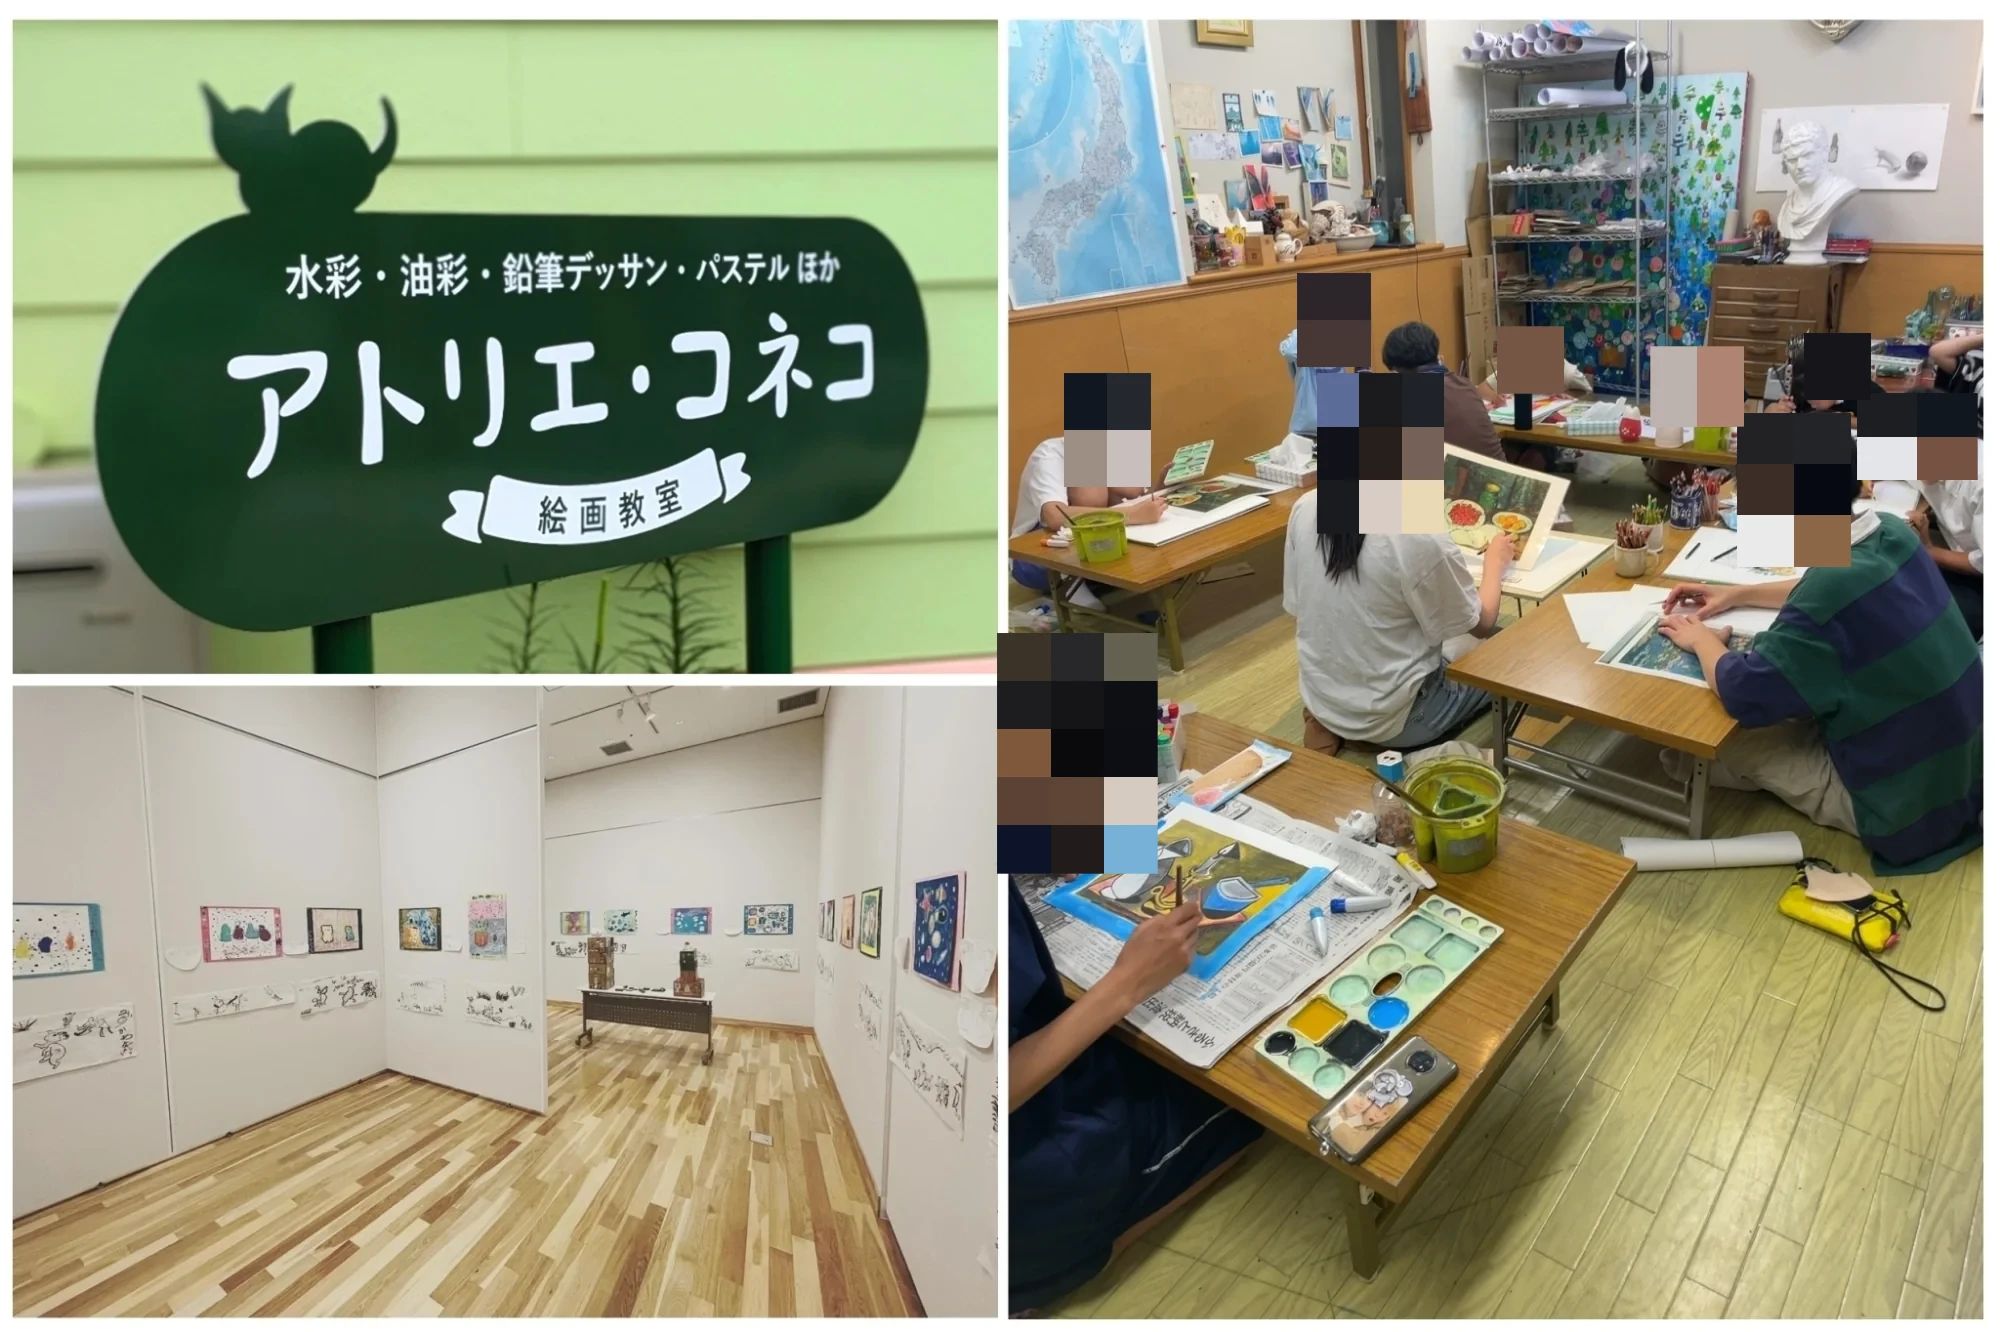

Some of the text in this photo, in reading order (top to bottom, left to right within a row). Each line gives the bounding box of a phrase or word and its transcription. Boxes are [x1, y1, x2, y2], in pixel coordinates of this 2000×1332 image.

[226, 312, 875, 480] アトリエ・コネコ
[538, 479, 683, 535] 絵画教室
